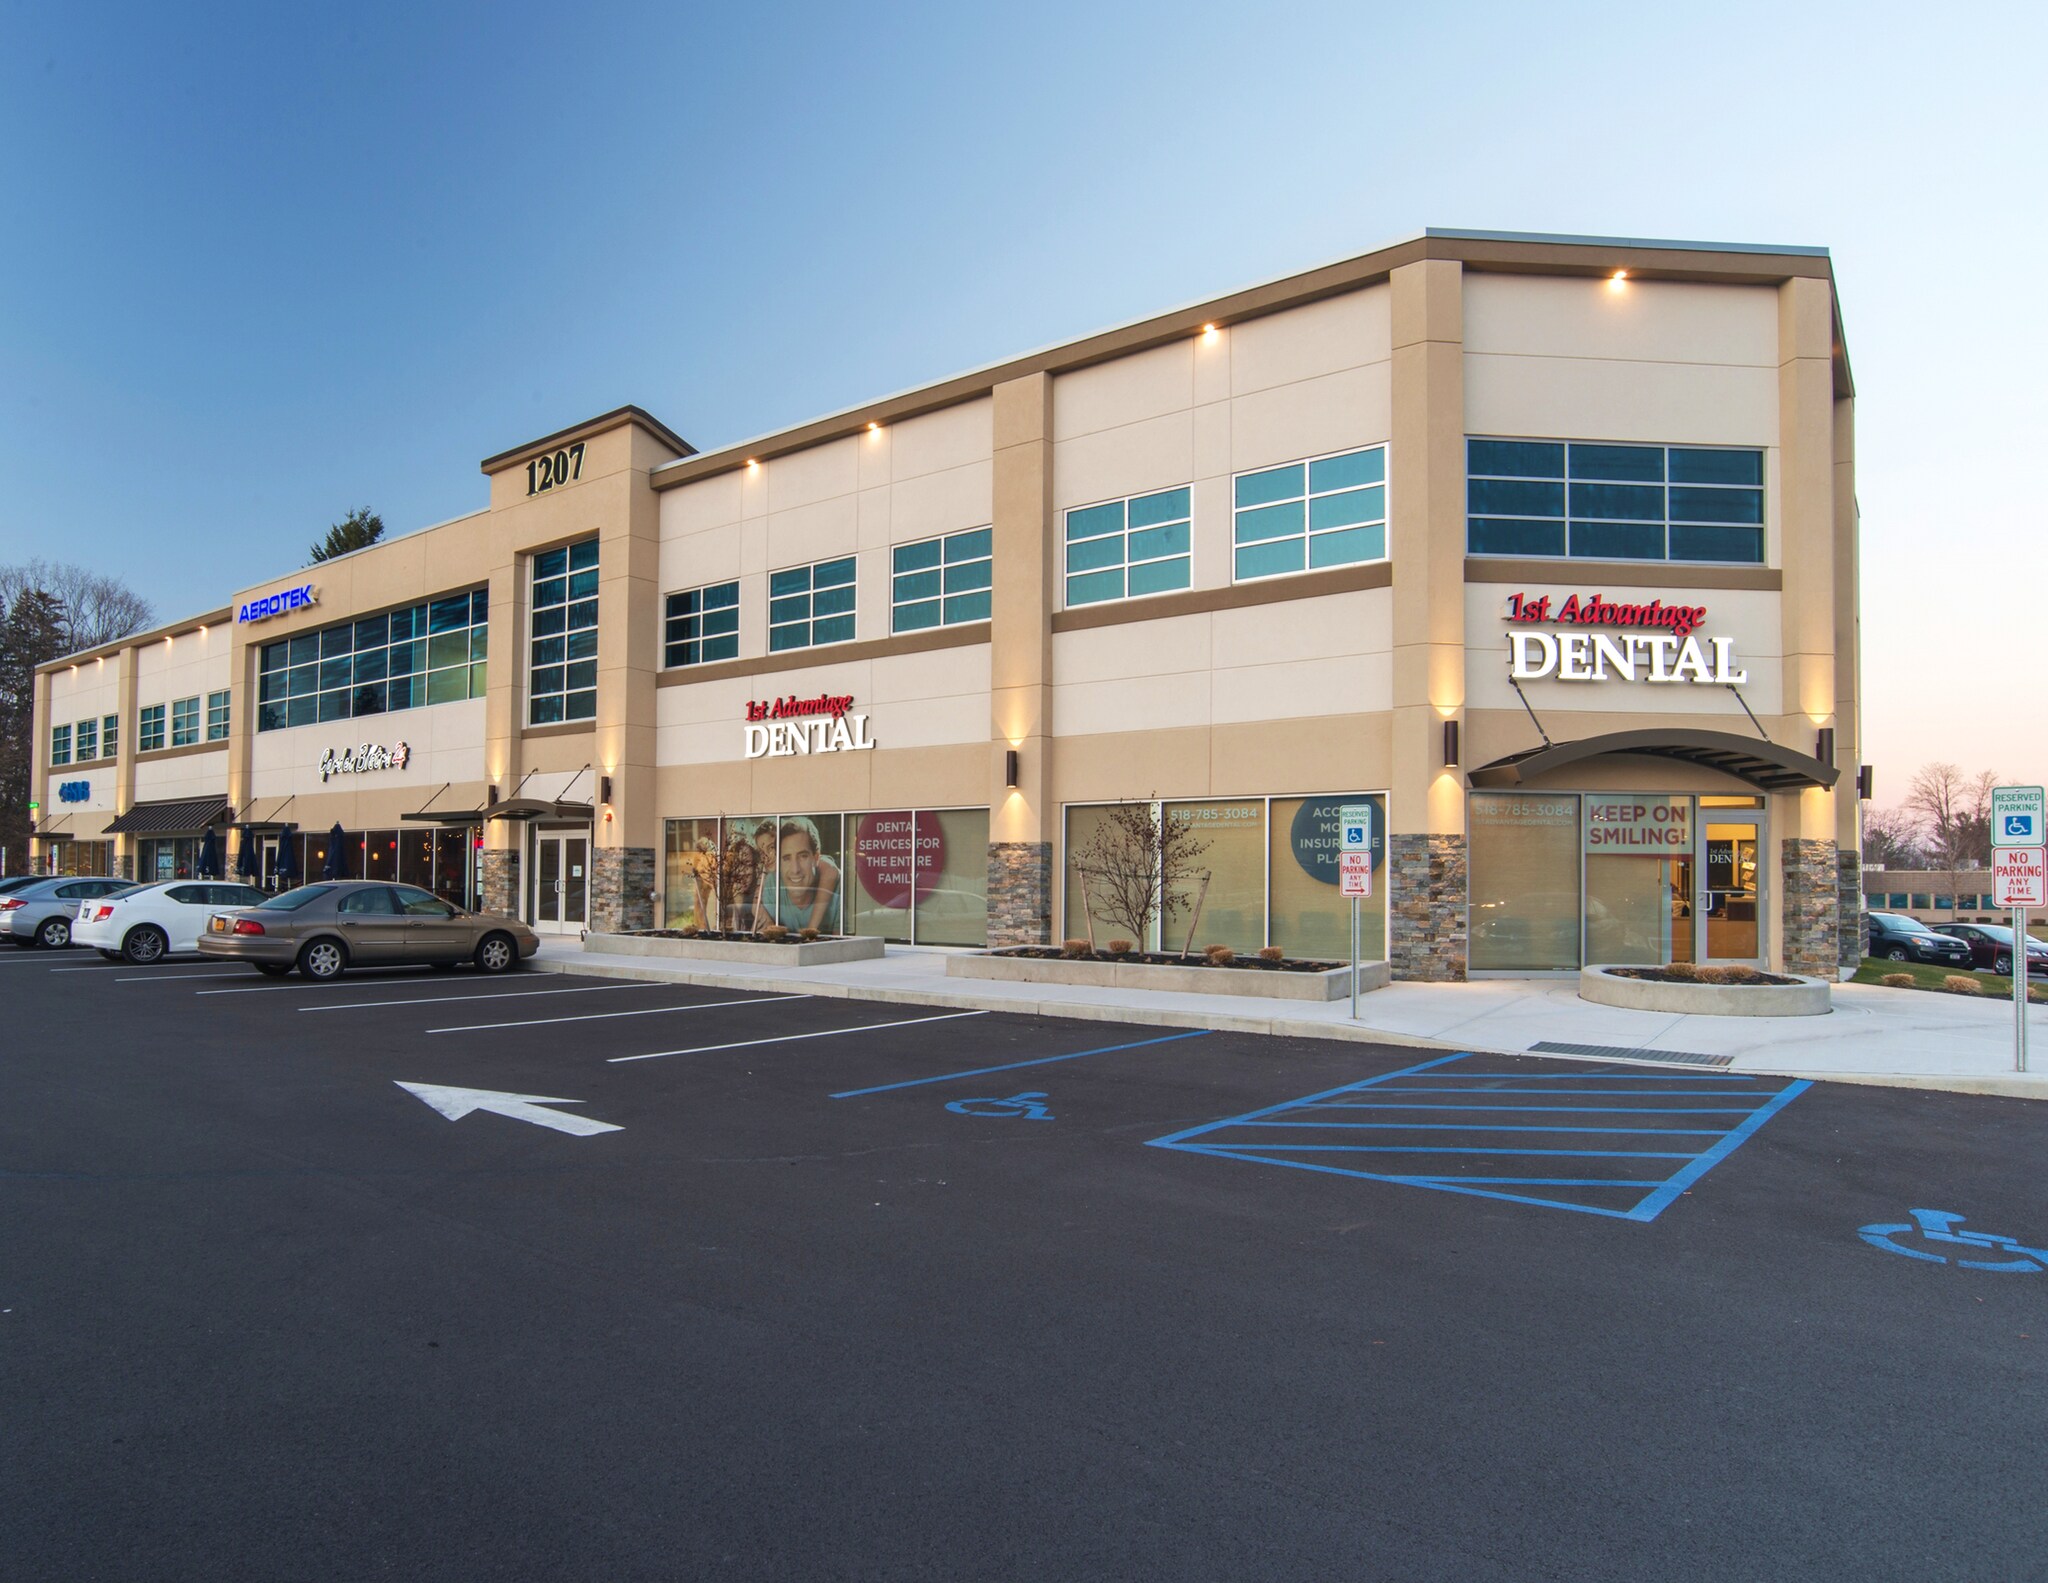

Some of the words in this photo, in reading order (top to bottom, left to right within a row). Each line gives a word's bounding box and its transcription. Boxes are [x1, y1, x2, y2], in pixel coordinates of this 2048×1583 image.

[526, 441, 587, 497] 1207
[238, 584, 312, 624] AEROTEK
[1509, 592, 1551, 623] 1st
[1555, 593, 1707, 637] Advantage
[1507, 631, 1748, 684] DENTAL
[745, 700, 768, 721] 1st
[768, 693, 854, 720] Advantage
[744, 714, 876, 759] DENTAL
[1995, 793, 2041, 802] RESERVED
[1998, 803, 2039, 812] PARKING
[1170, 807, 1258, 821] 518-785-3084
[1342, 810, 1369, 818] RESERVED
[1590, 805, 1647, 822] KEEP
[1652, 805, 1686, 823] ON
[1589, 827, 1686, 845] SMILING!
[859, 838, 912, 850] SERVICES
[916, 837, 940, 849] FOR
[866, 856, 887, 867] THE
[889, 855, 932, 867] ENTRE
[1349, 855, 1362, 865] NO
[2009, 852, 2029, 864] NO
[1342, 865, 1369, 875] PARKING
[1996, 865, 2042, 877] PARKING
[2009, 878, 2030, 886] ANY
[2007, 886, 2032, 895] TIME
